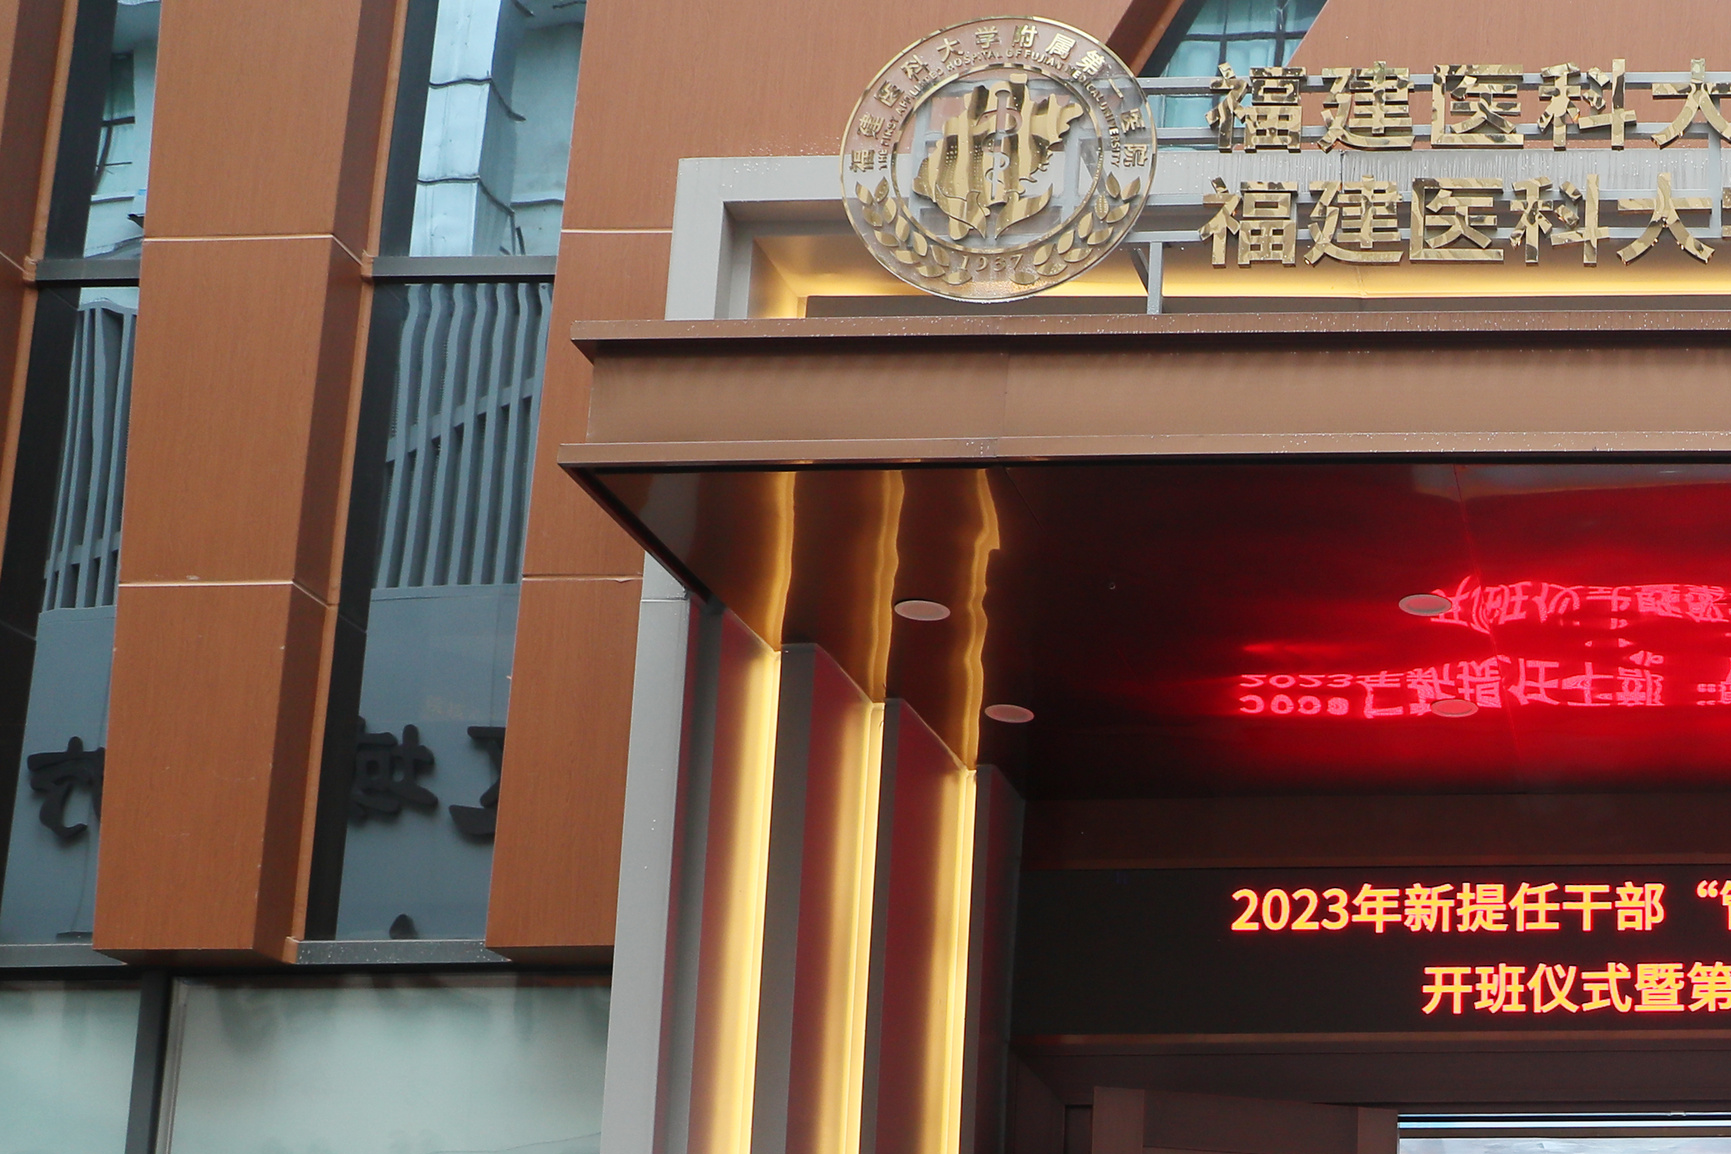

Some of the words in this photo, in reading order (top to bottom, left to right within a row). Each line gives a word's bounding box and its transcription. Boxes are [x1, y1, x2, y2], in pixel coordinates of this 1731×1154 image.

[849, 24, 1149, 173] 福建医科大学附属第一医院
[880, 116, 900, 148] FIRST
[946, 50, 1003, 73] HOSPITAL
[1024, 49, 1063, 71] FUJIAN
[959, 253, 1024, 272] 1937
